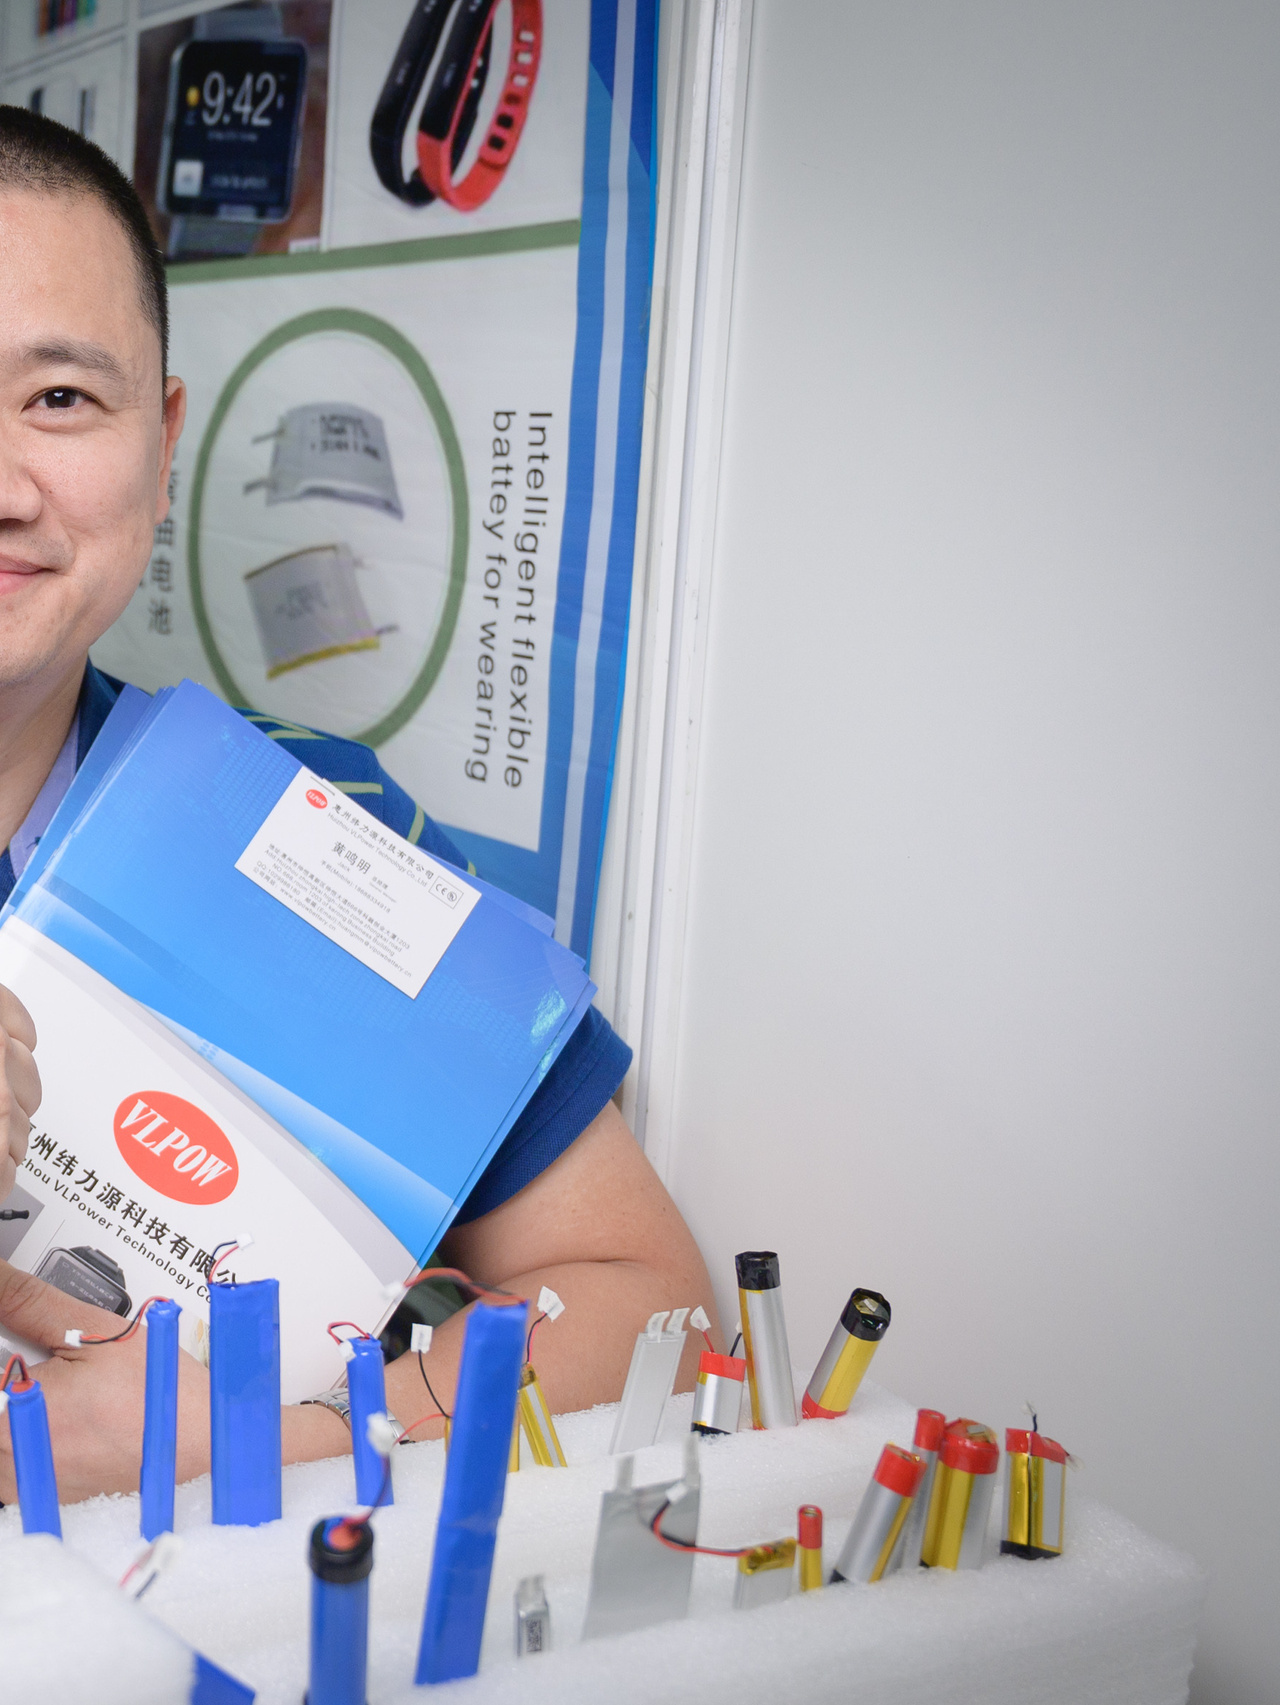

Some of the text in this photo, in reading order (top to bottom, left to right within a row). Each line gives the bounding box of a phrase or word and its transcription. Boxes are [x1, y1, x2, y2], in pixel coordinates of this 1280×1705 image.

[202, 71, 277, 126] 9:42
[465, 411, 517, 783] battey for wearing
[504, 412, 552, 788] Intelligent flexible
[327, 813, 349, 831] Huizhou
[350, 830, 374, 849] VLPower
[374, 847, 406, 872] Technology
[331, 841, 371, 874] 黄鸣明
[337, 861, 350, 871] Jack
[372, 937, 395, 956] Building
[389, 940, 401, 951] road
[120, 1099, 232, 1187] VLPOW
[29, 1122, 237, 1286] 州纬力源科技有限公
[53, 1180, 113, 1230] VLPower
[118, 1225, 195, 1290] Technology
